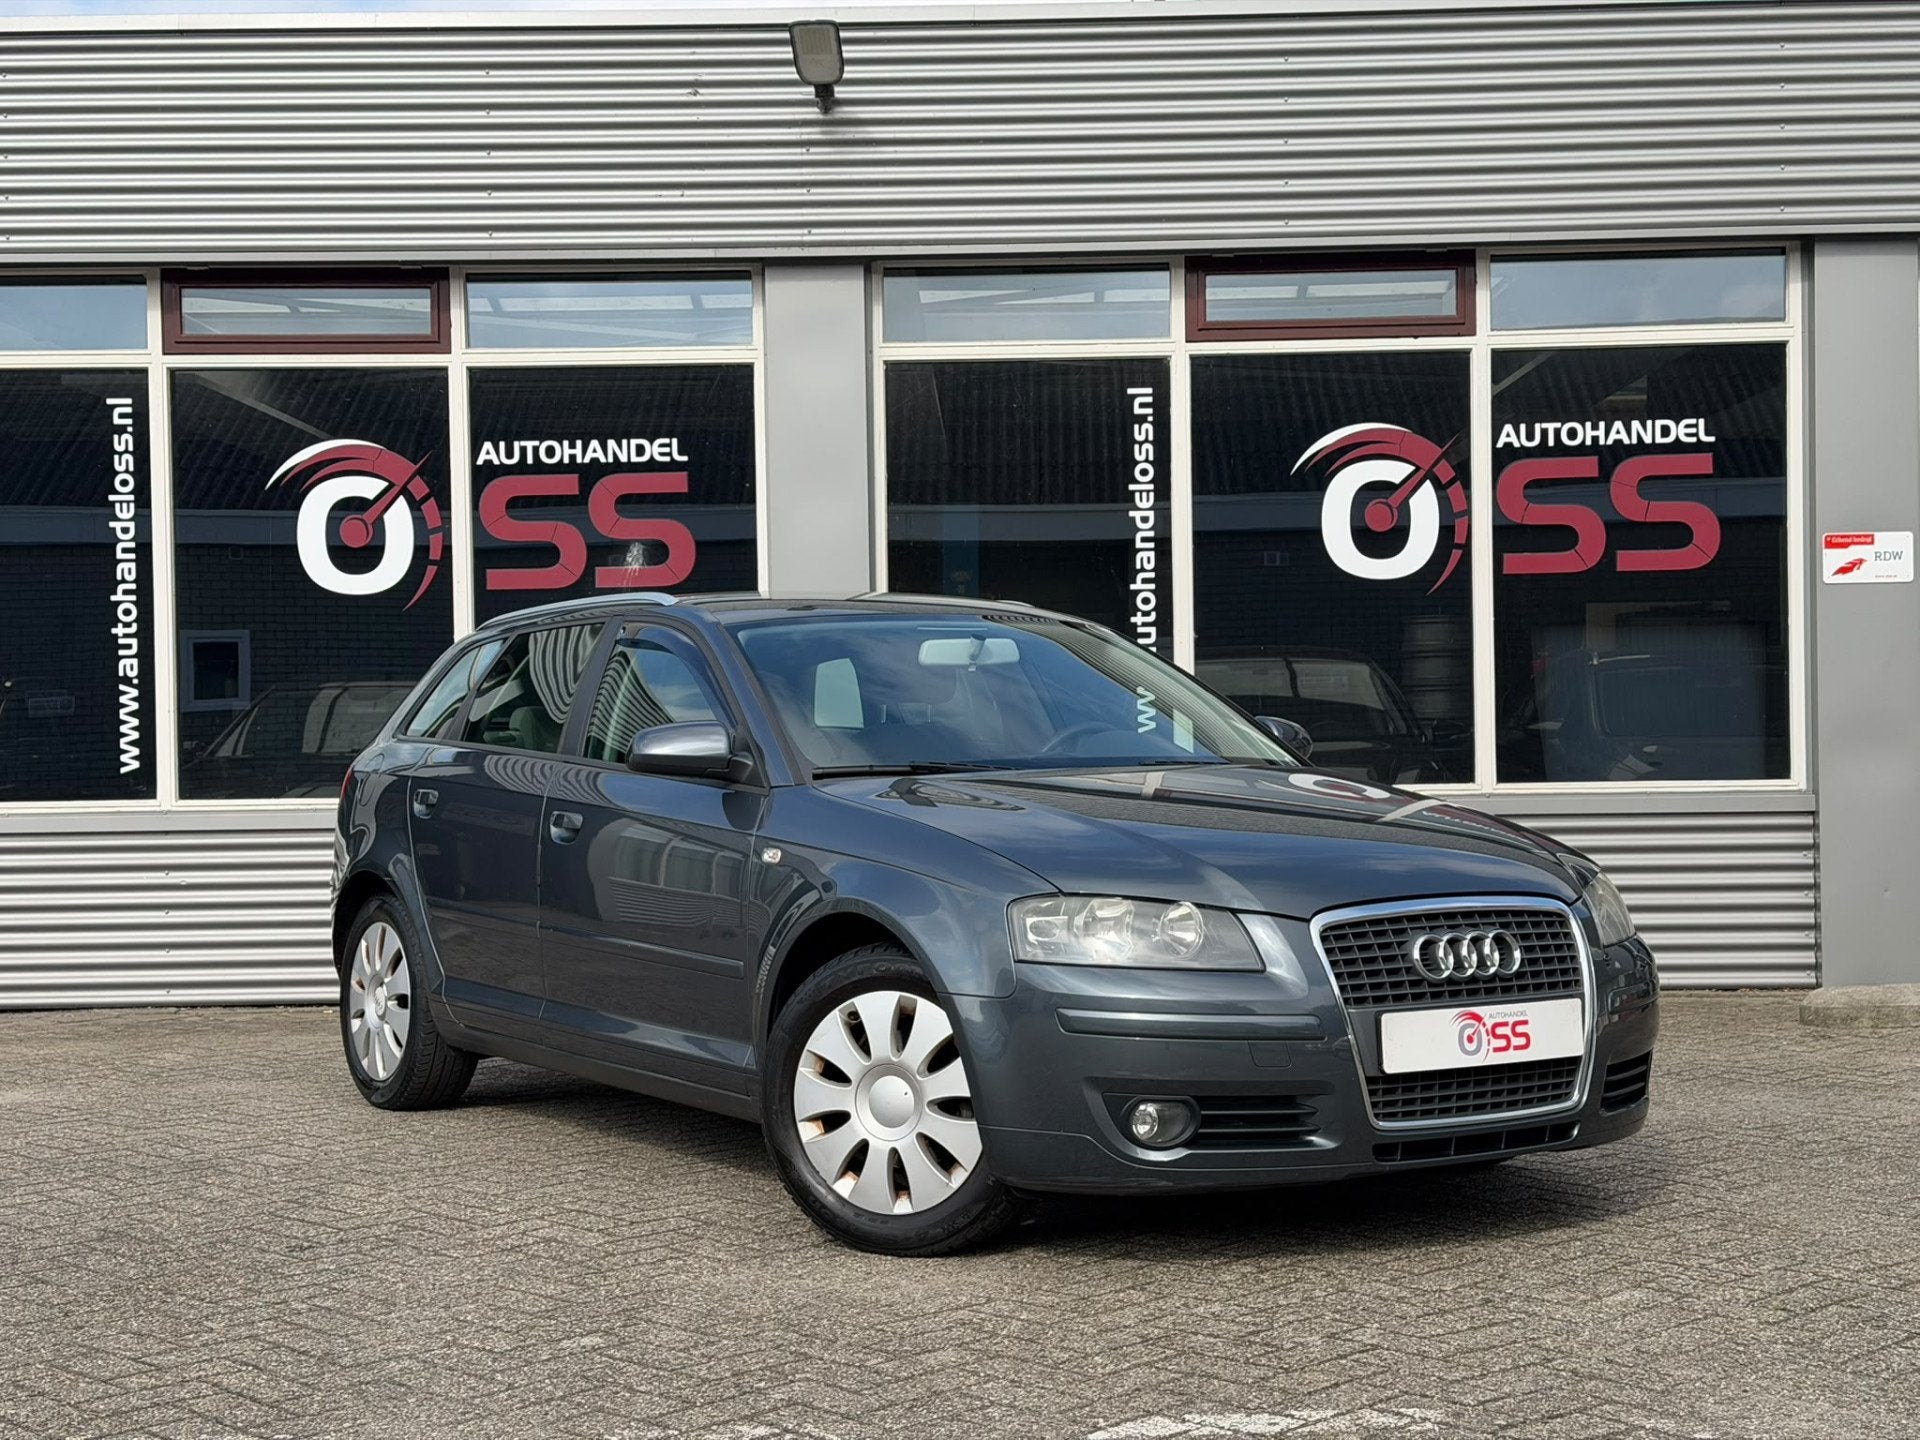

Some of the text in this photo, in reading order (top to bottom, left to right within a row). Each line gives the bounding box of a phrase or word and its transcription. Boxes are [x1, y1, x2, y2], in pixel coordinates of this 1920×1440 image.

[1496, 418, 1716, 448] AUTOHANDEL
[477, 437, 689, 466] AUTOHANDEL
[1874, 550, 1904, 562] RDW
[106, 397, 140, 774] www.autohandeloss.nl
